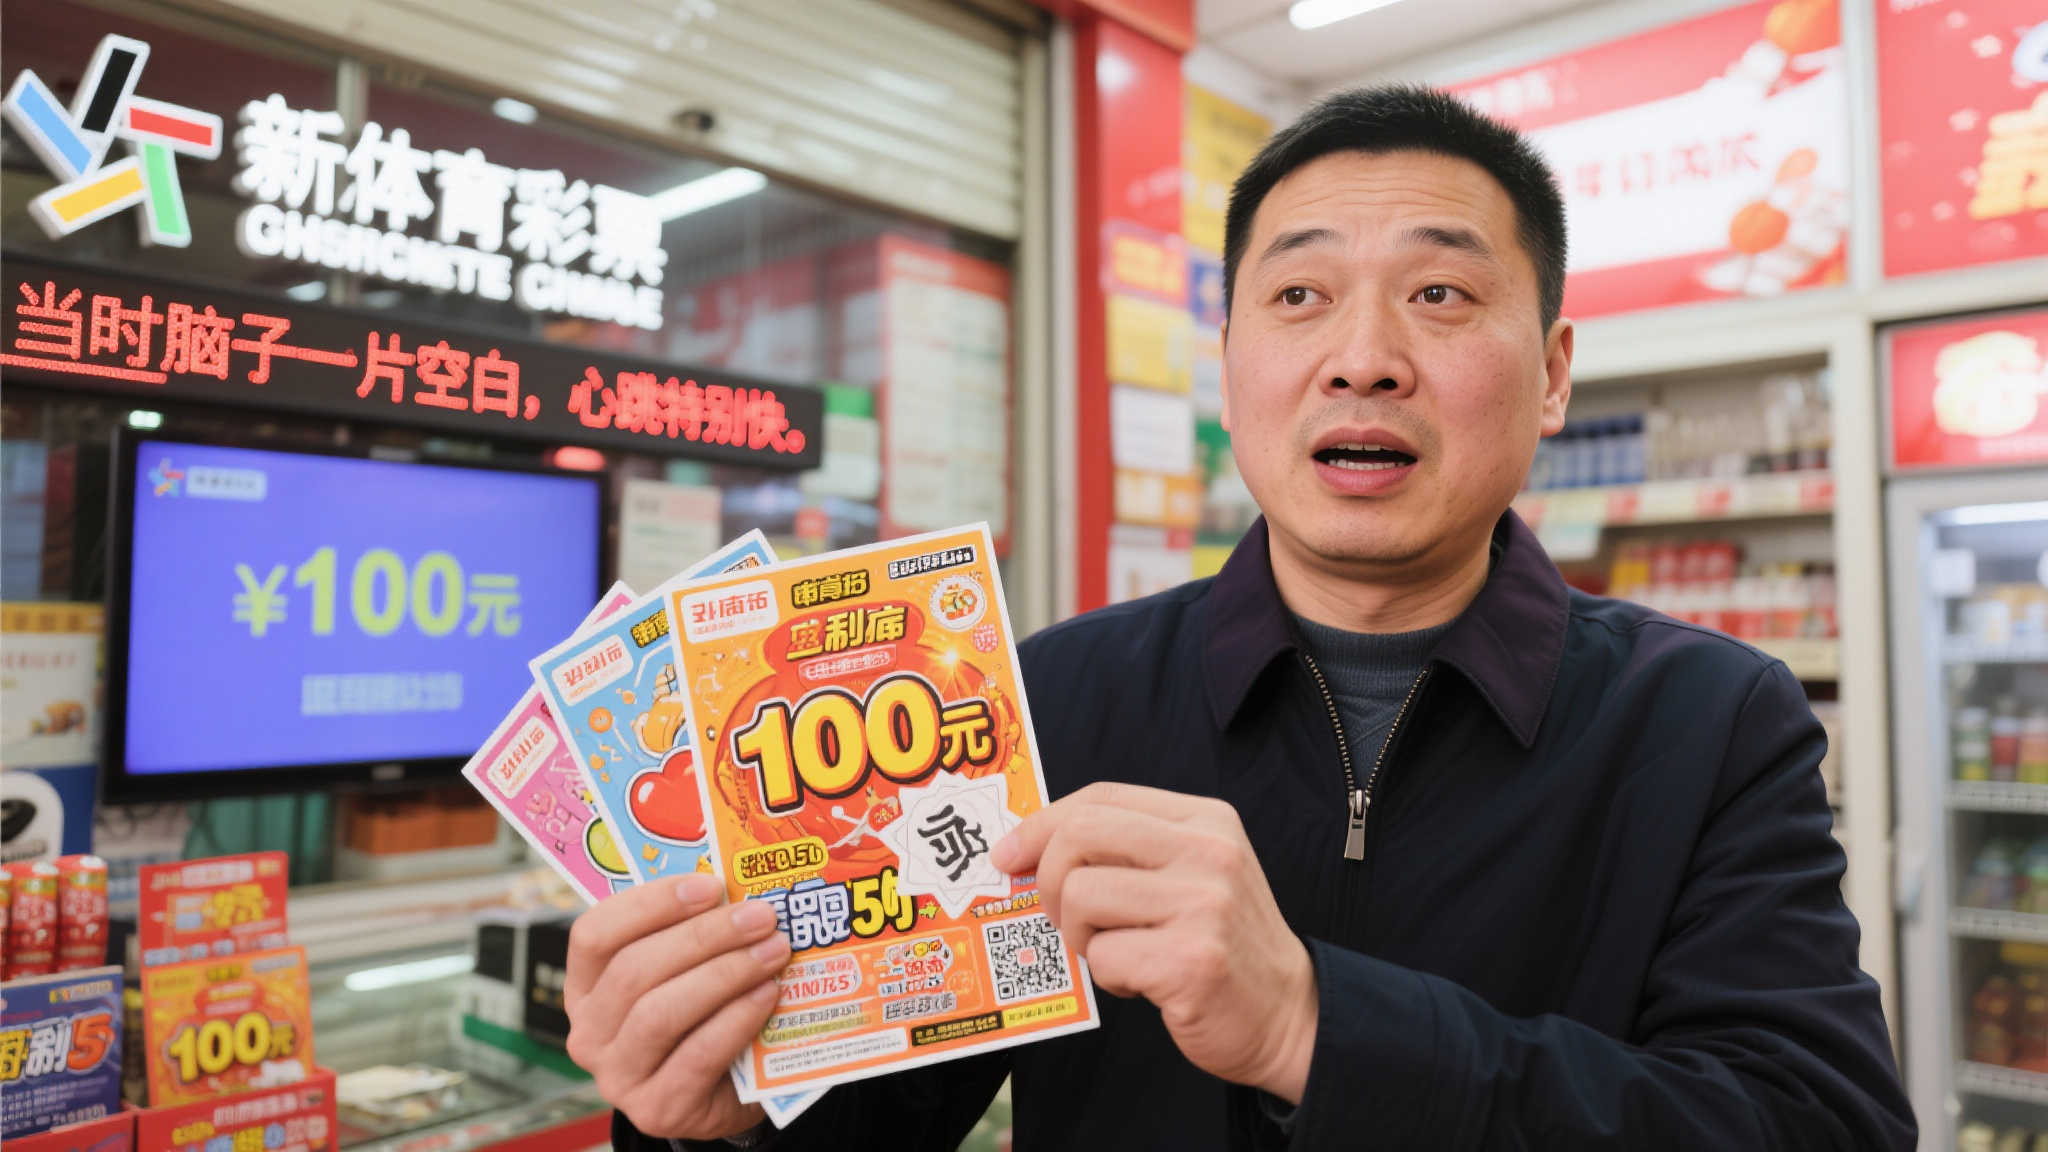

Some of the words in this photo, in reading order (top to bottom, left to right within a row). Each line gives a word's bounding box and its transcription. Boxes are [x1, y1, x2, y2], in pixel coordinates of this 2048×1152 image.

[235, 93, 668, 286] 新体育彩票
[734, 674, 998, 814] 100元
